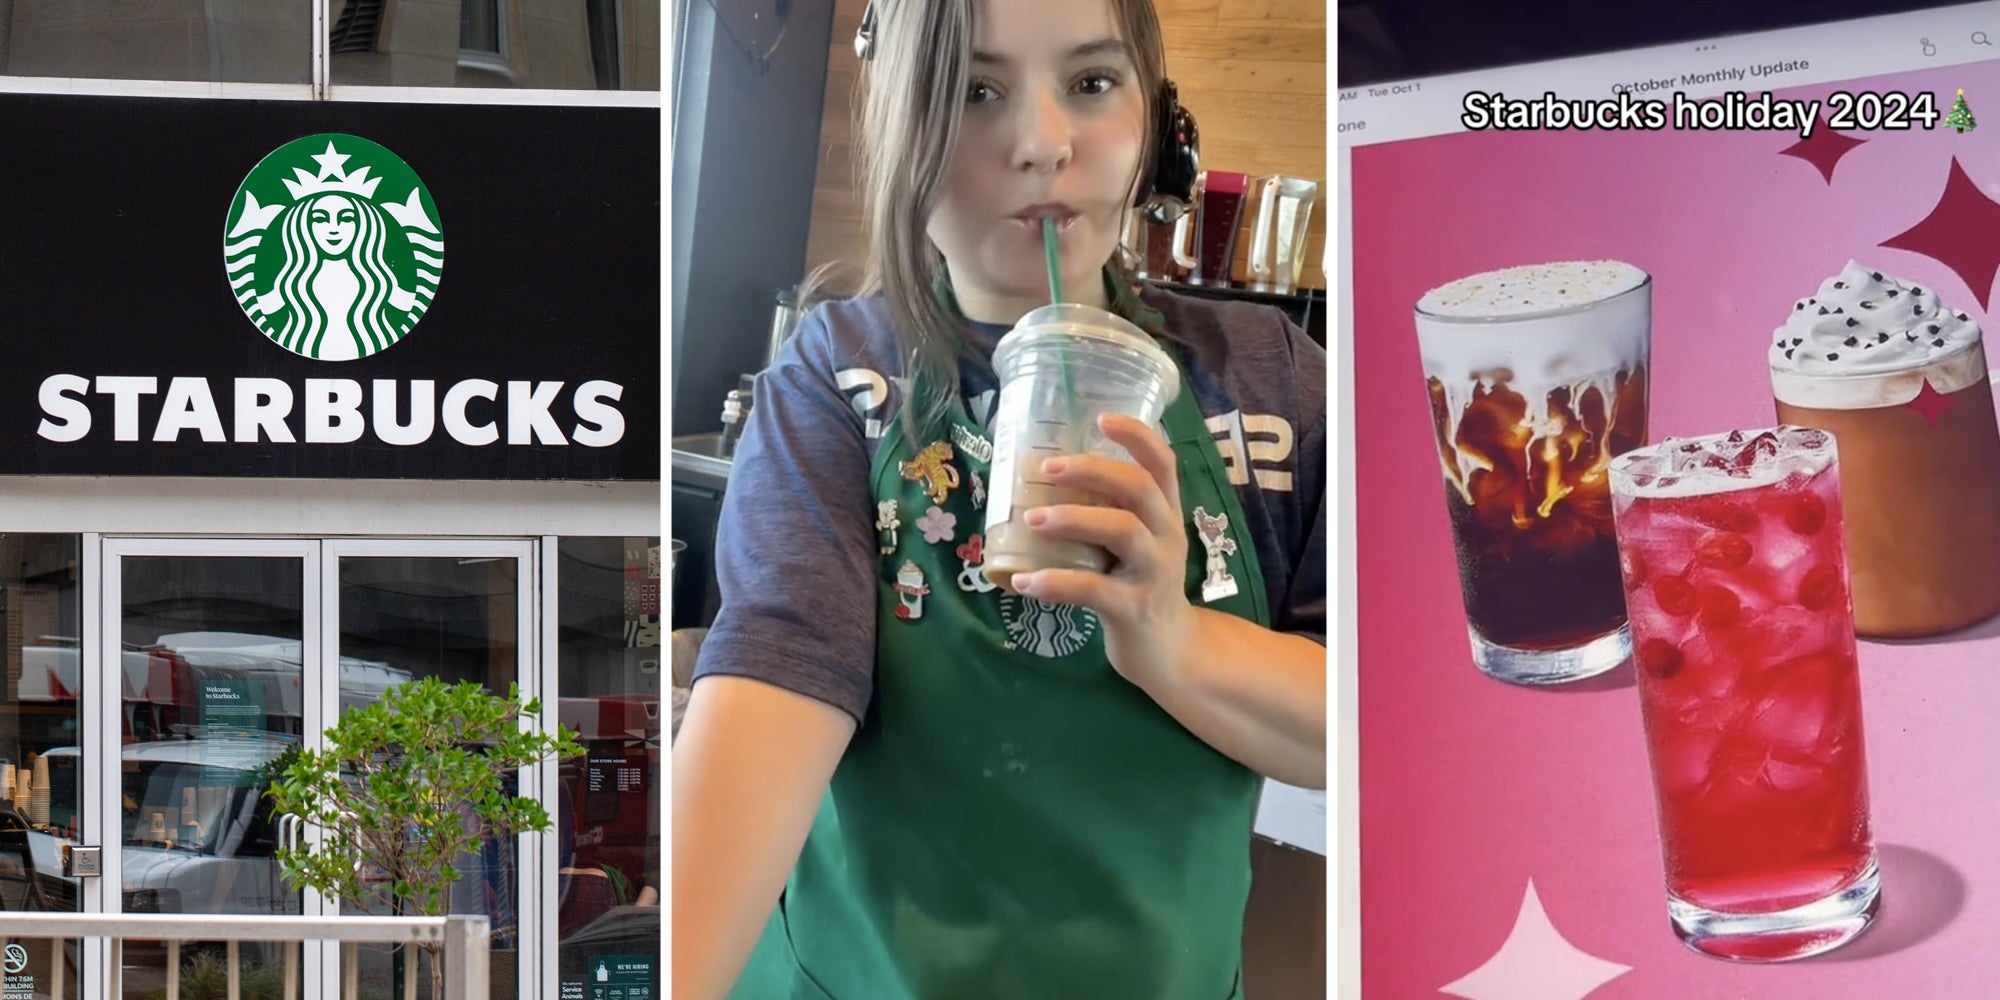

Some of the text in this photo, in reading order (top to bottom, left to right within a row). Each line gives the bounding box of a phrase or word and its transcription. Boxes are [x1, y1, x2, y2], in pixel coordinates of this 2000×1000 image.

[1339, 83, 1421, 101] AM Tue Oct 1
[1611, 60, 1809, 95] October Monthly Update
[36, 373, 626, 447] STARBUCKS
